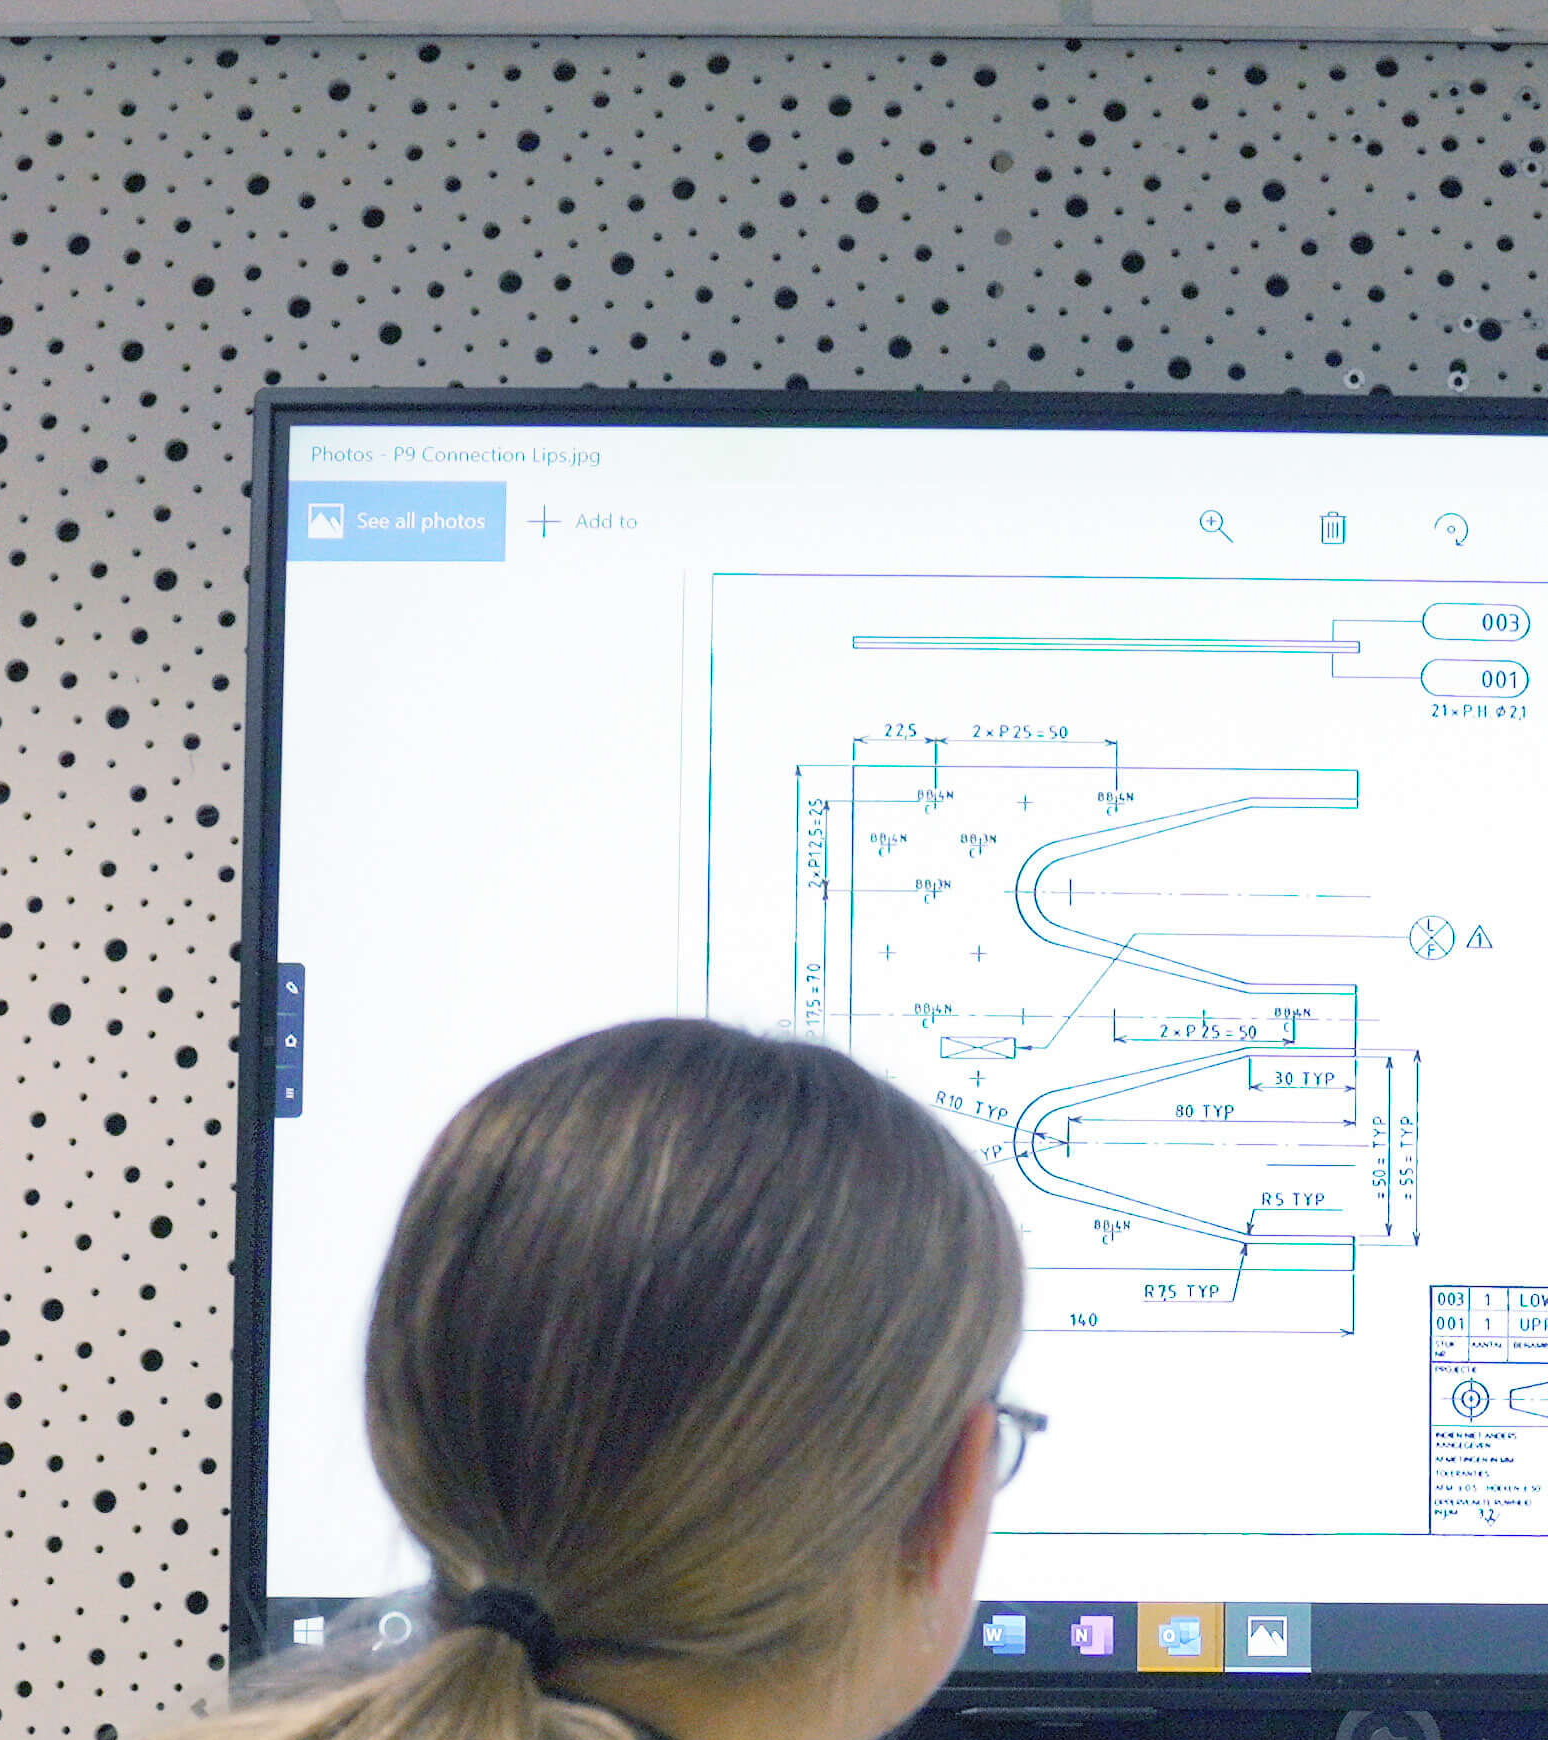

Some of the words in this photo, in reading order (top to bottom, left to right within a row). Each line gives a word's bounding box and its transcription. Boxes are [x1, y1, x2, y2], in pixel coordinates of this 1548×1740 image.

[311, 445, 373, 463] Photos
[393, 445, 416, 463] P9
[421, 446, 527, 463] Connection
[532, 447, 601, 467] Lips.jpg
[357, 513, 390, 529] See
[396, 512, 415, 529] all
[421, 512, 484, 532] photos
[576, 512, 613, 529] Add
[619, 516, 638, 529] to
[1481, 613, 1519, 632] 003
[1481, 670, 1517, 689] 001
[1275, 1071, 1294, 1086] 30
[1299, 1071, 1335, 1089] TYP
[936, 1090, 962, 1110] R10
[975, 1101, 1008, 1120] TYP
[1175, 1104, 1195, 1118] 80
[1203, 1104, 1238, 1123] TYP
[1261, 1192, 1285, 1207] R5
[1293, 1192, 1325, 1207] TYP
[1187, 1284, 1220, 1299] TYP
[1437, 1291, 1464, 1307] 003
[1484, 1293, 1490, 1307] 1
[1070, 1312, 1099, 1327] 140
[1436, 1316, 1464, 1331] 001
[1484, 1317, 1490, 1331] 1
[986, 1629, 1002, 1641] W
[1076, 1630, 1088, 1641] N
[1163, 1630, 1174, 1642] O
